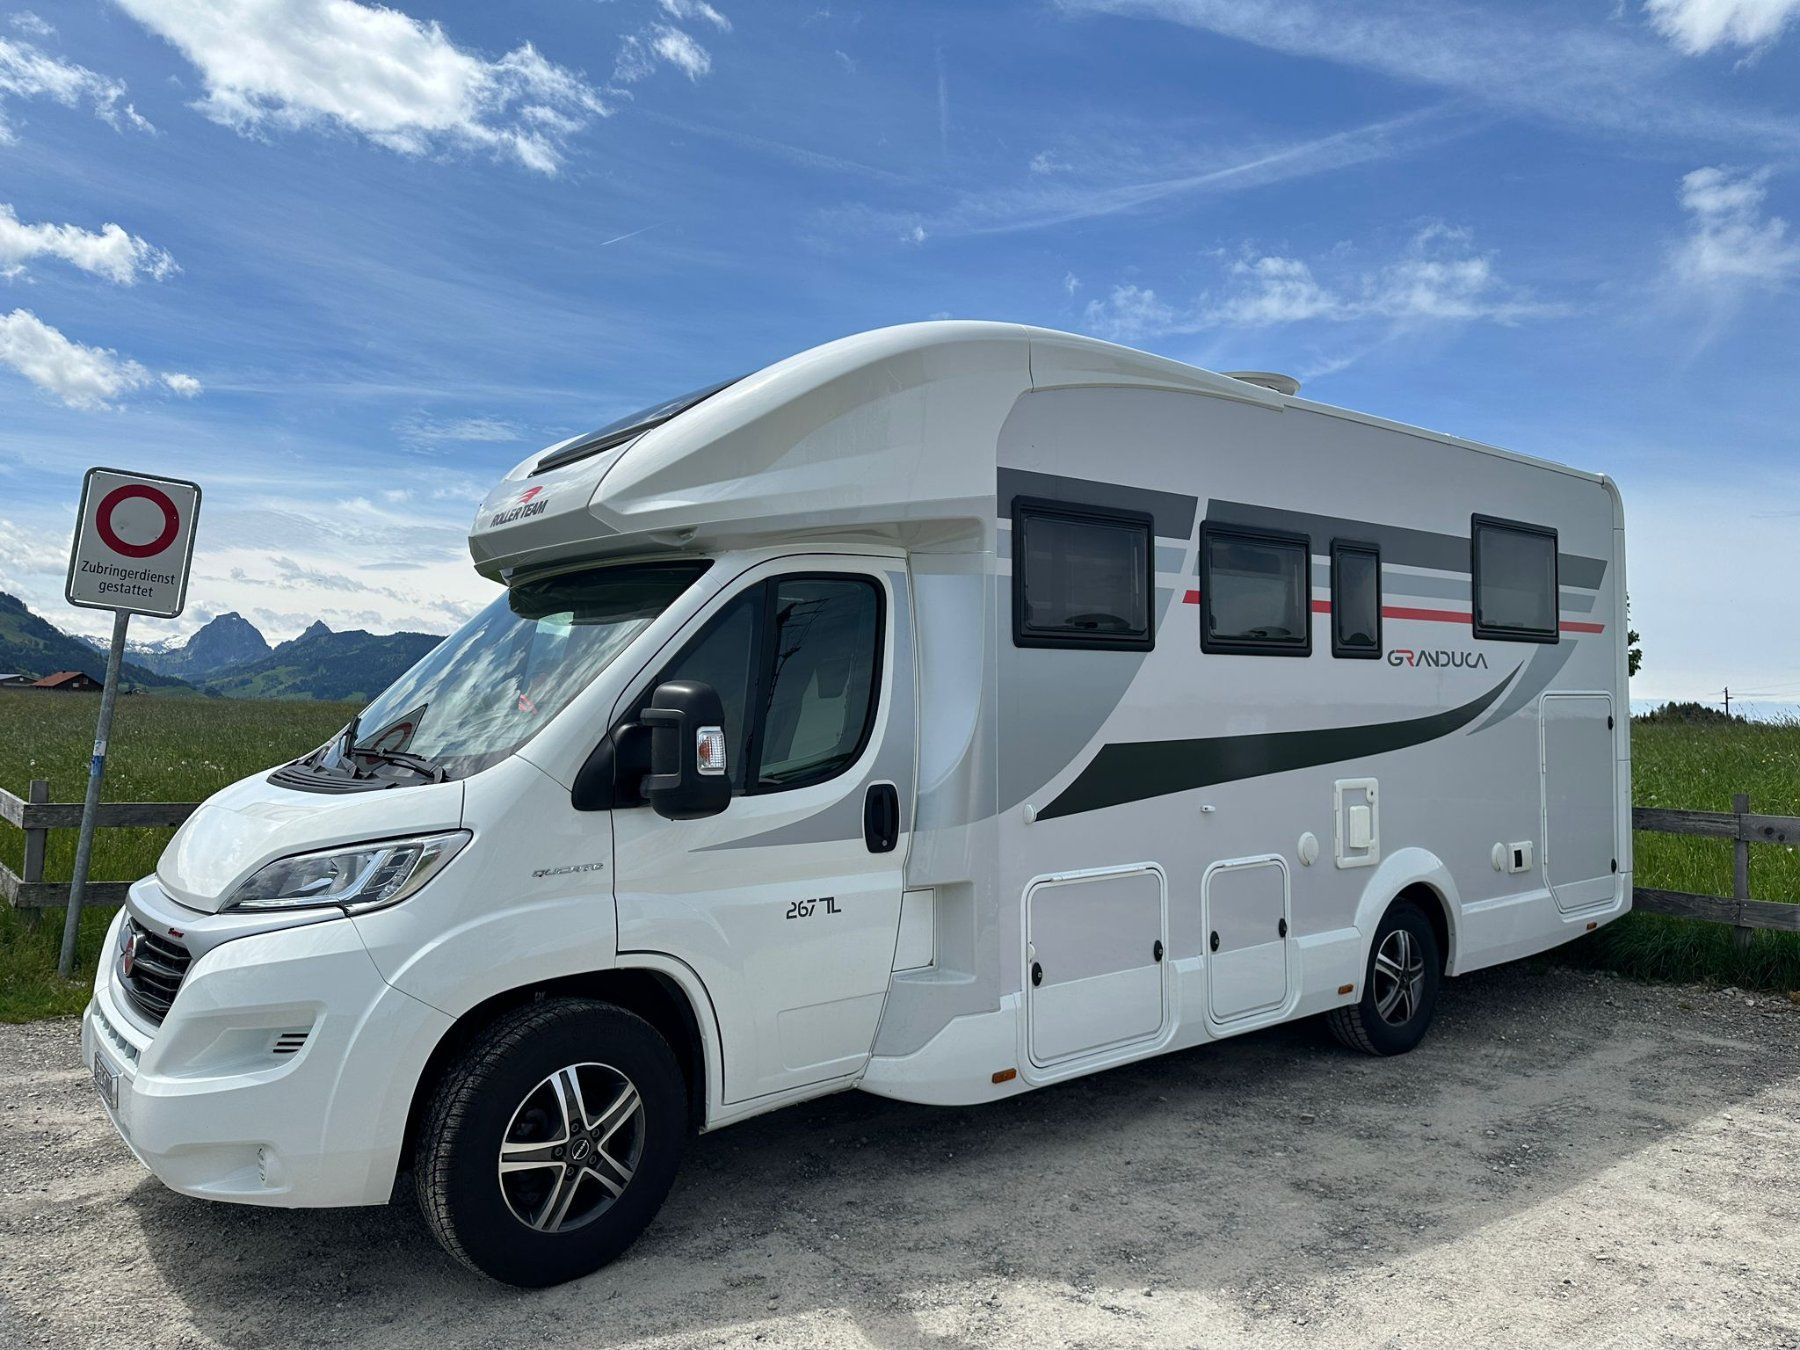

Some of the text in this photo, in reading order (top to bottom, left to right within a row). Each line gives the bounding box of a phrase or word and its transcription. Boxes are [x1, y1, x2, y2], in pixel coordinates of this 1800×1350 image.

[490, 499, 549, 528] ROLLER TEAM
[81, 560, 175, 585] Zubringerdienst
[98, 581, 154, 597] gestattet
[1387, 649, 1488, 669] GRANDUCA
[786, 899, 817, 920] 267
